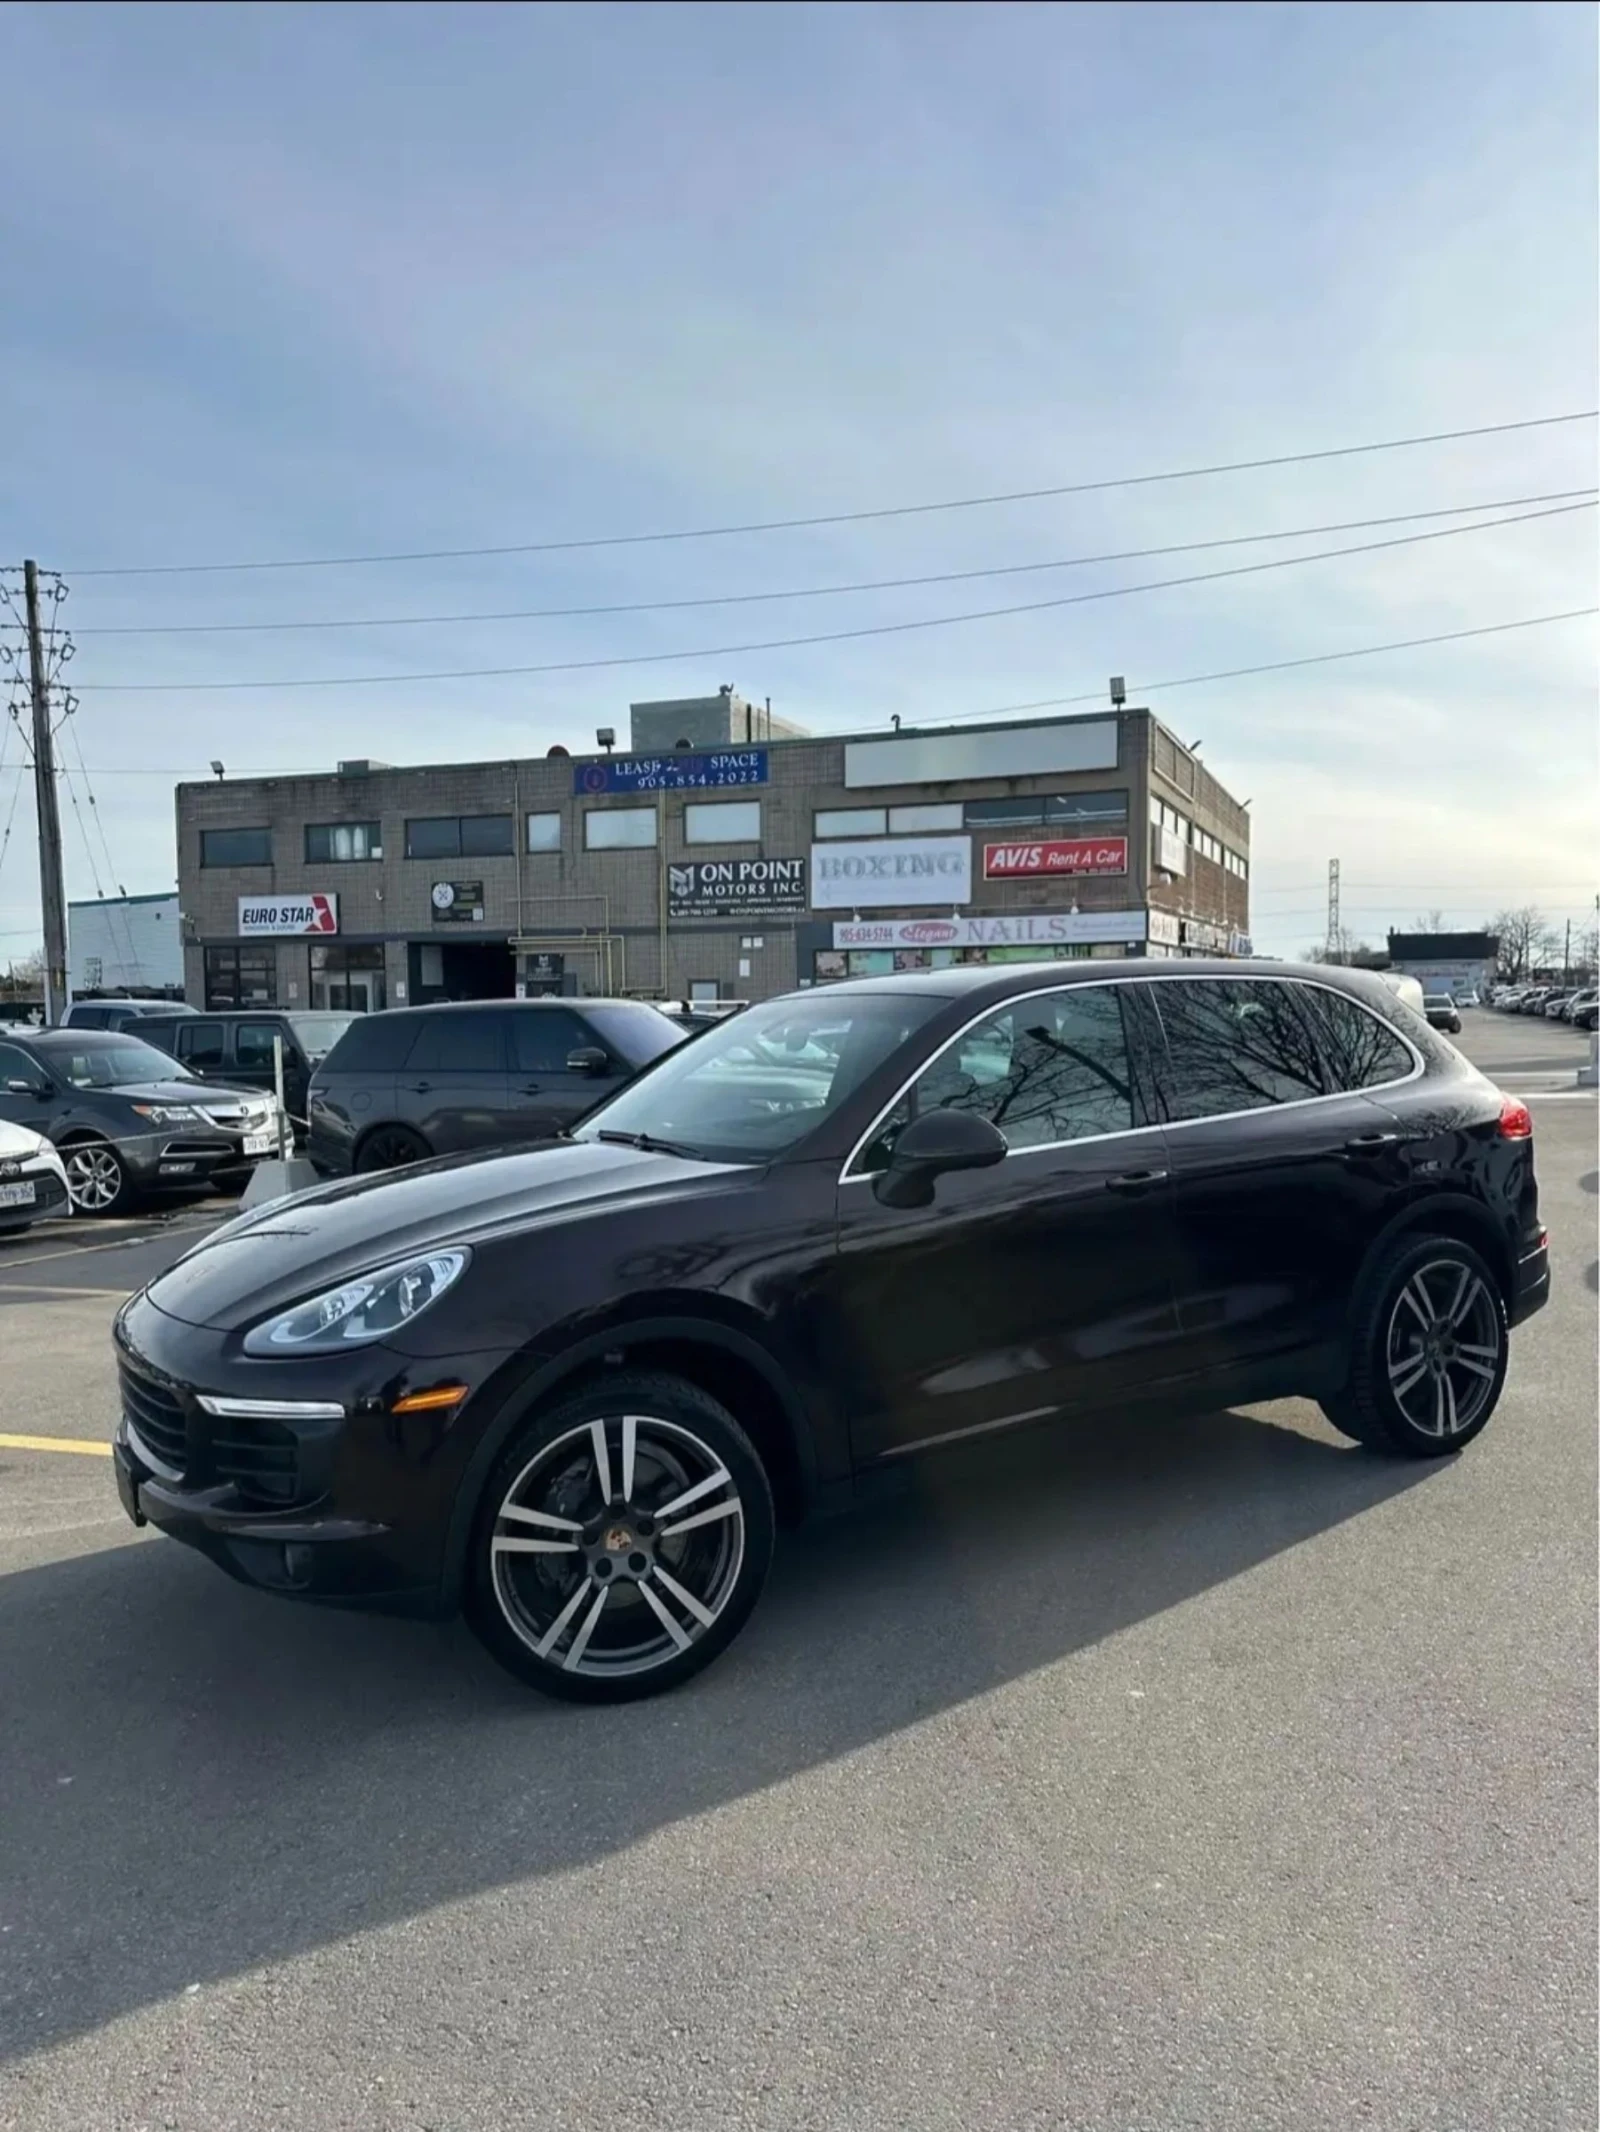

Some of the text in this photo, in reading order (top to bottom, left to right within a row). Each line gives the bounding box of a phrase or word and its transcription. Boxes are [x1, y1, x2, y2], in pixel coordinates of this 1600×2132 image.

[711, 754, 758, 769] SPACE
[637, 771, 758, 789] 905.854.2022
[820, 852, 964, 880] BOXING
[991, 848, 1122, 869] AVIS Rent A Car
[700, 860, 804, 882] ON POINT
[702, 884, 766, 897] MOTORS
[242, 907, 314, 924] EURO STAR
[903, 925, 955, 942] Elegant
